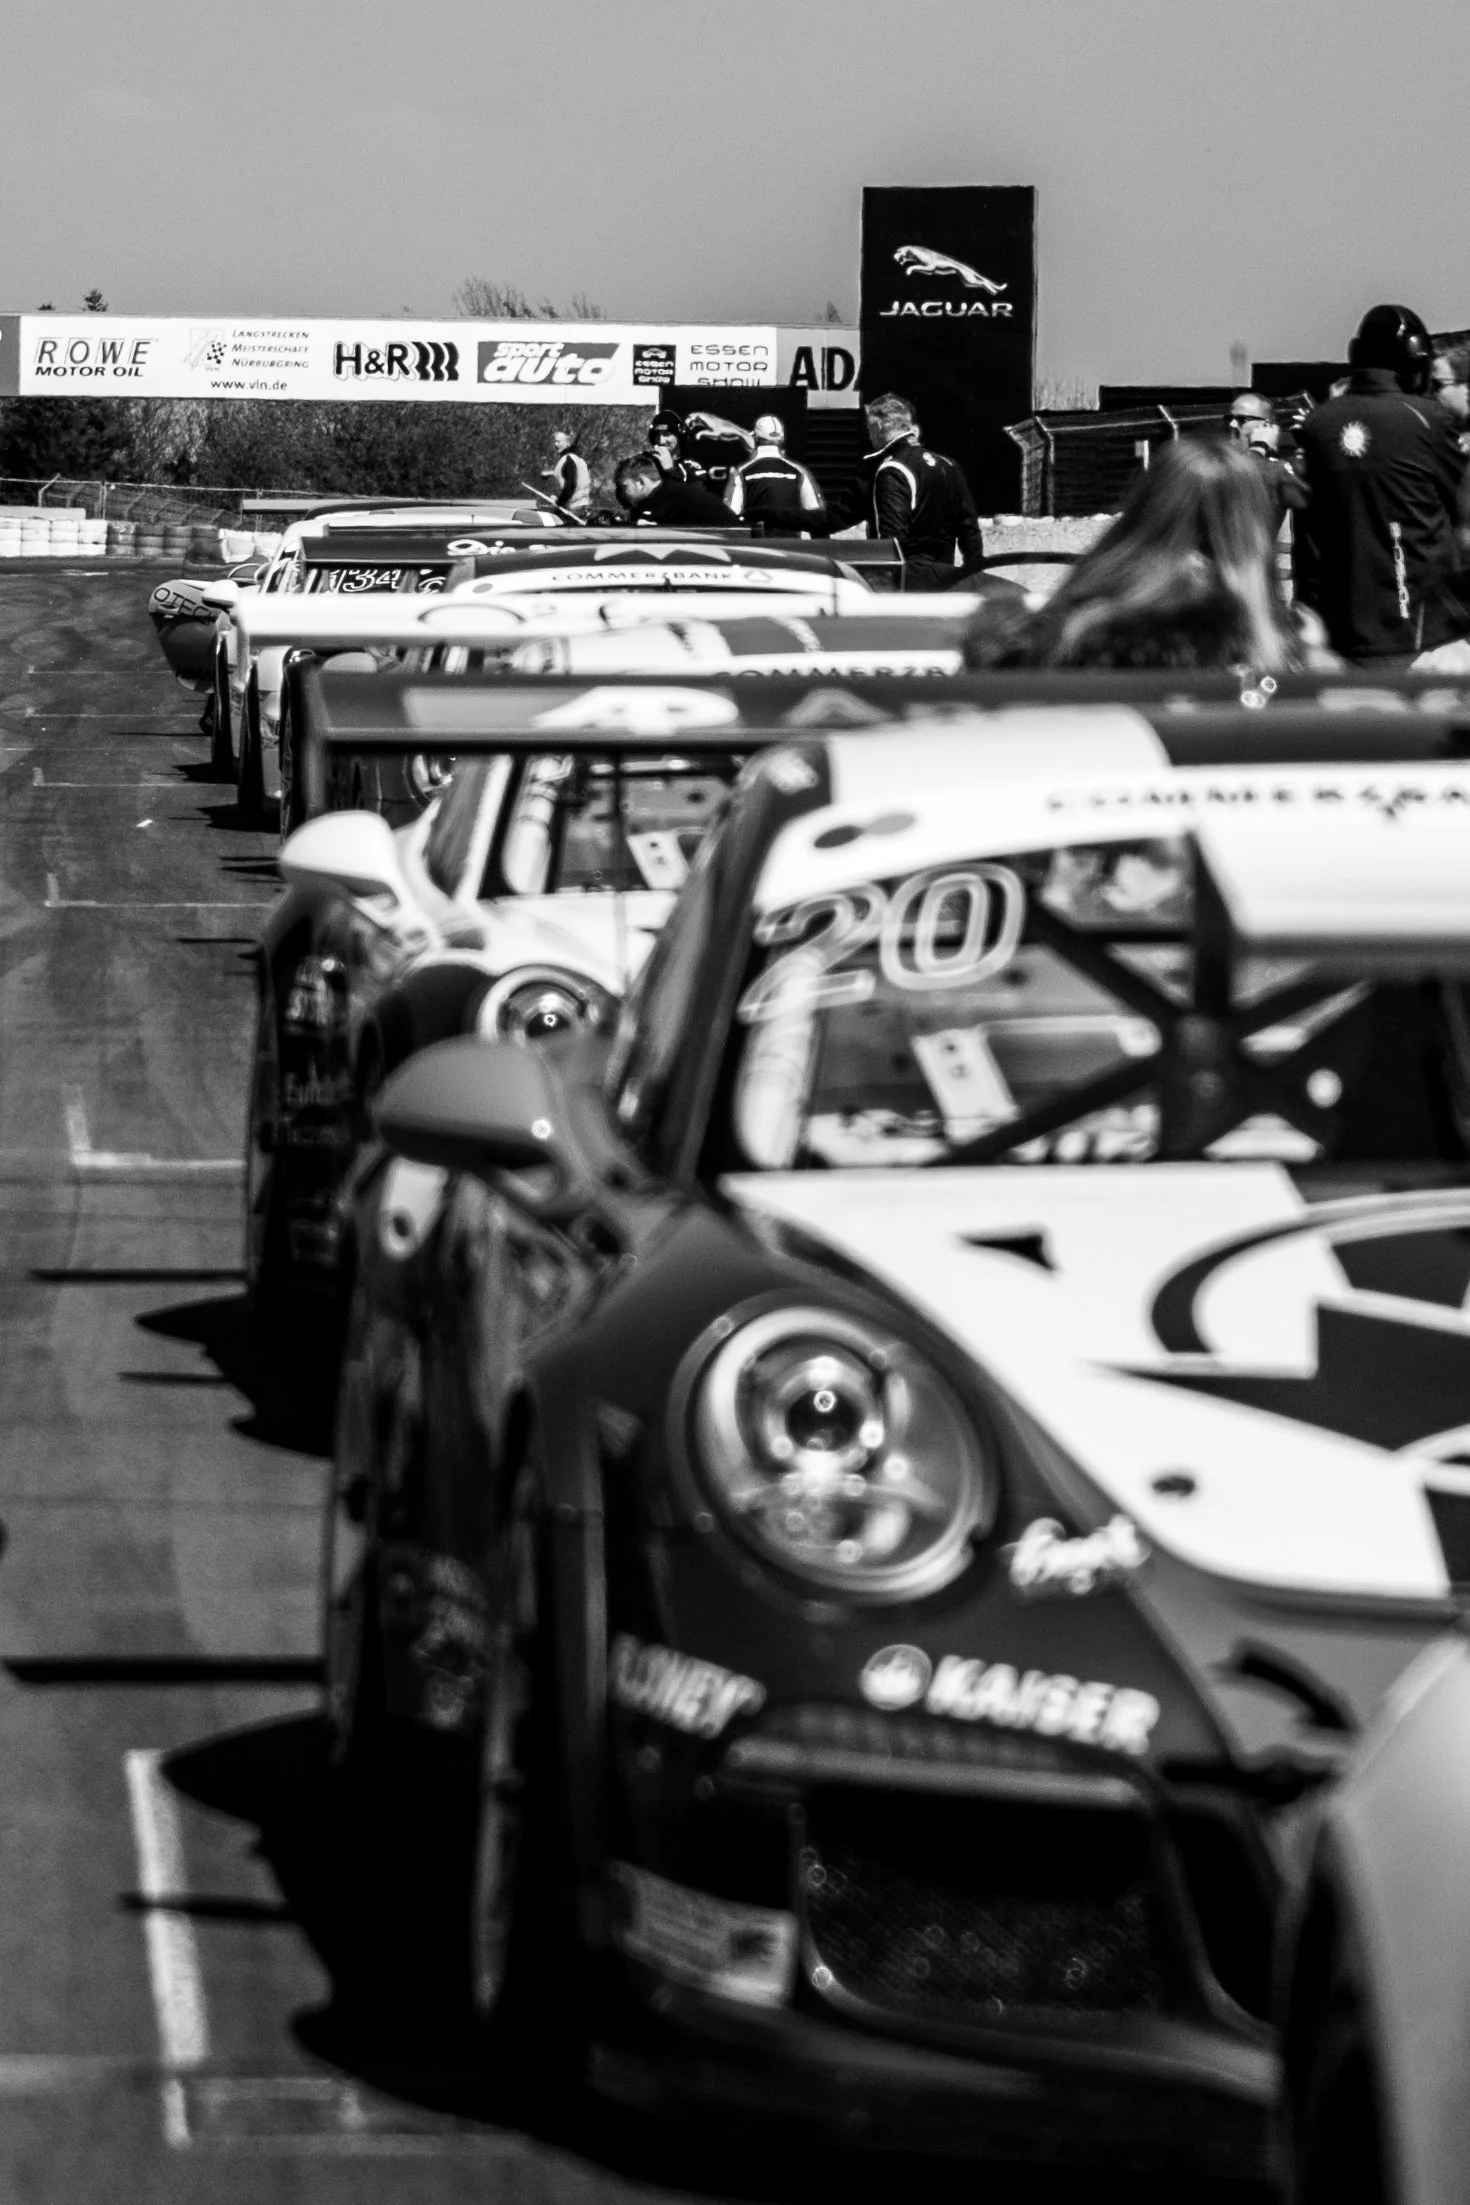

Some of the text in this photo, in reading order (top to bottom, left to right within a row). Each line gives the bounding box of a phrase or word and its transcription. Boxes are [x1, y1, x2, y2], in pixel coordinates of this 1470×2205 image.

[879, 301, 1013, 317] JAGUAR
[37, 339, 151, 365] ROWE
[335, 343, 410, 376] H&R
[494, 342, 564, 358] sport
[690, 344, 768, 356] ESSEN
[35, 366, 144, 377] MOTOR OIL
[483, 353, 616, 384] auto
[690, 361, 768, 372] MOTOR
[788, 346, 861, 392] AD
[210, 379, 288, 391] www.vln.de
[737, 861, 1025, 1025] 20
[926, 1655, 1159, 1755] KAISER
